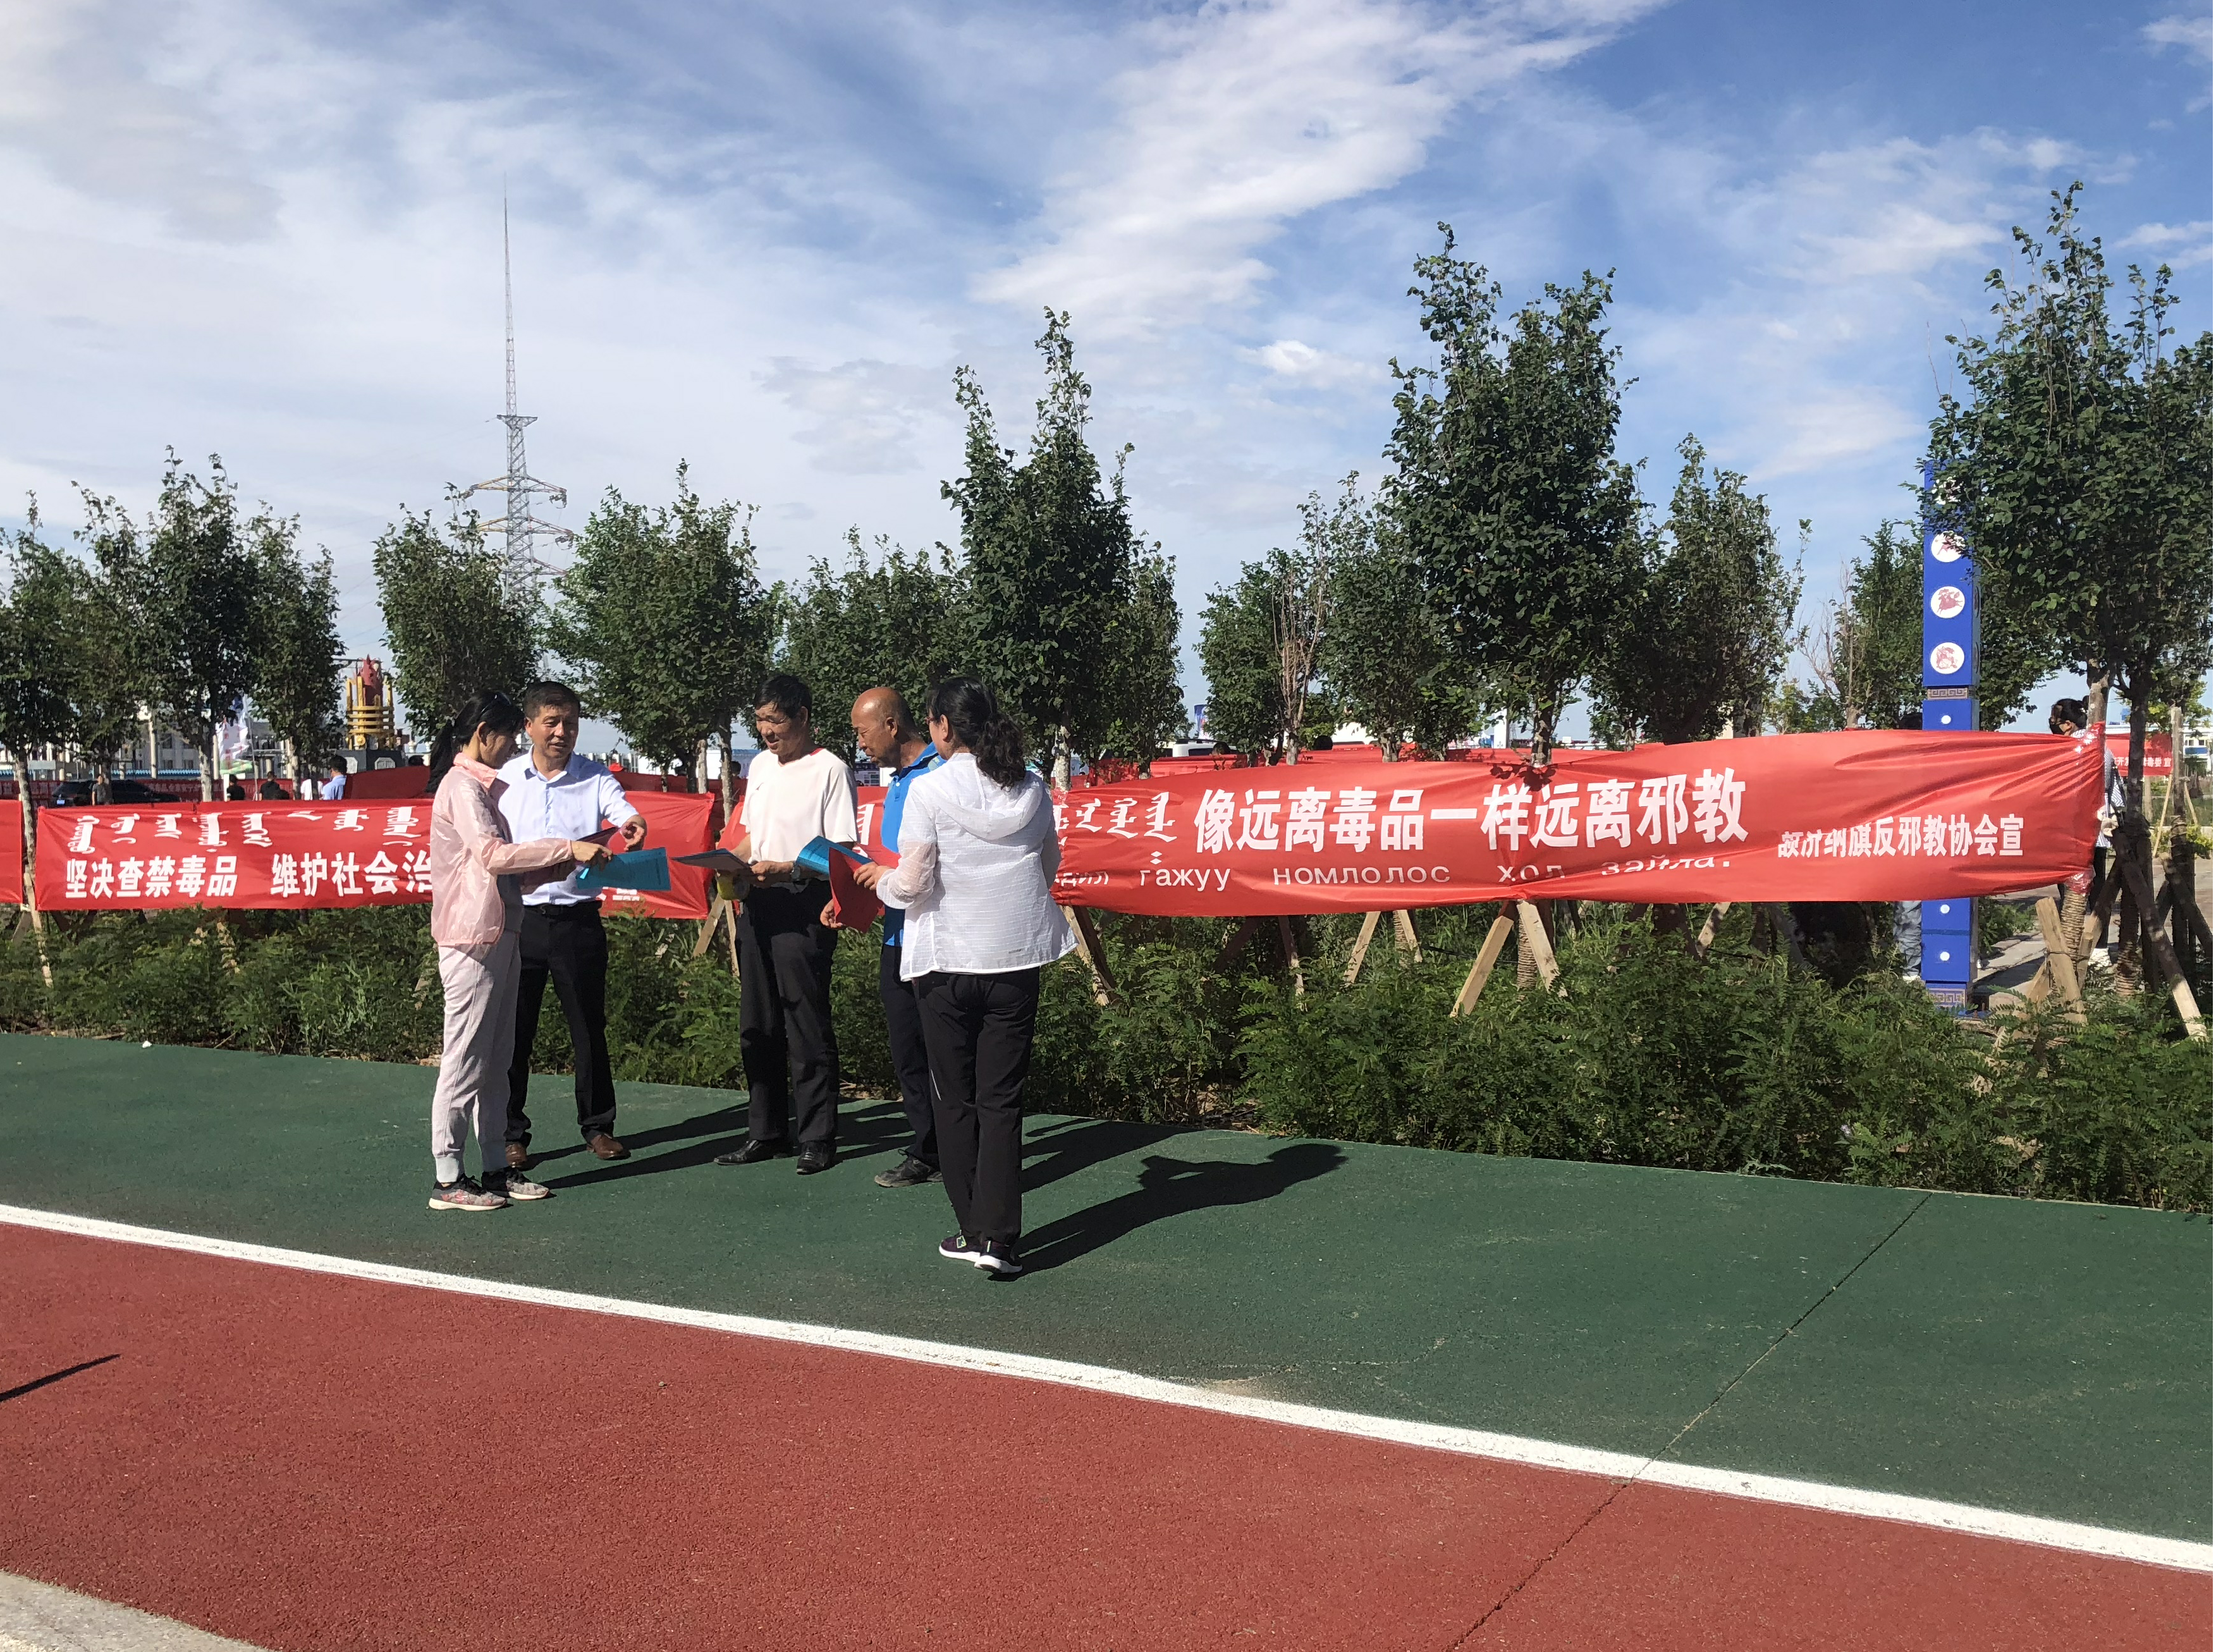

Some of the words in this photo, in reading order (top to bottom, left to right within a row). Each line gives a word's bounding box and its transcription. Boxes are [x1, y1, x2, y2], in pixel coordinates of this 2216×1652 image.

[1194, 767, 1749, 854] 像远离毒品一样远离邪教
[65, 854, 238, 899] 坚决查禁毒品
[270, 850, 433, 898] 维护社会治
[1139, 868, 1231, 891] гажуу
[1273, 866, 1450, 885] номлолос
[1497, 864, 1566, 883] хол
